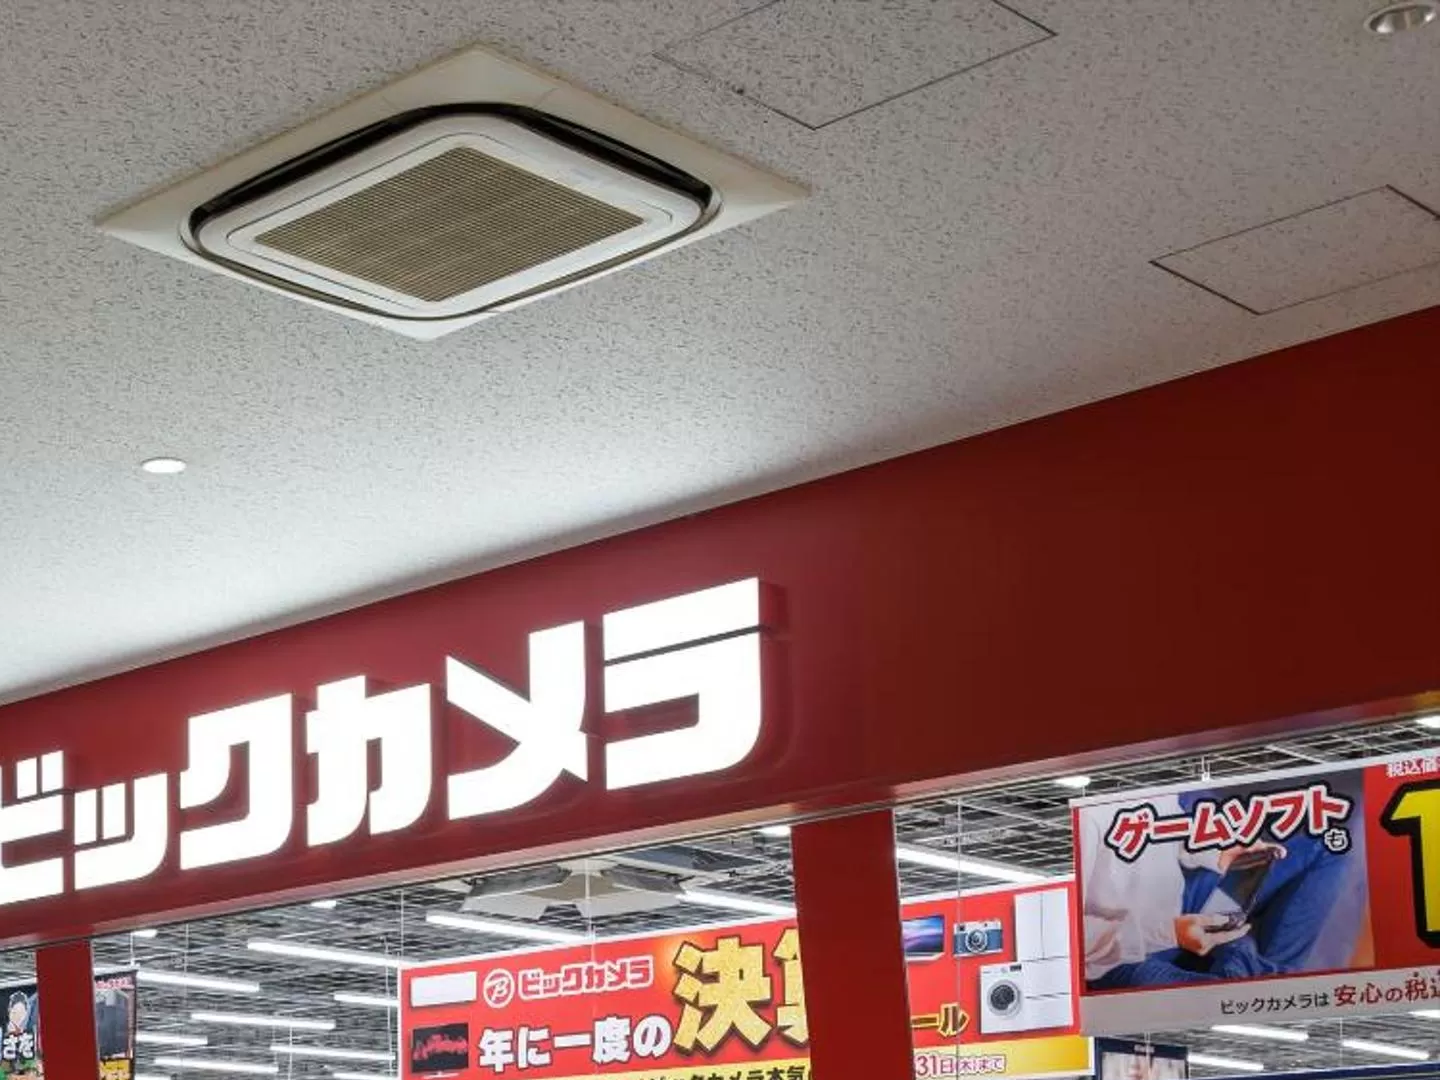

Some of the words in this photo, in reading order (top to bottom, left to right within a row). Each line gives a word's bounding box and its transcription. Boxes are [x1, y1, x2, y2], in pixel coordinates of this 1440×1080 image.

[1387, 756, 1440, 778] 税込価
[1110, 785, 1350, 858] ゲームソフトも
[519, 957, 653, 999] ビックカメラ
[478, 1016, 673, 1073] 年に一度の
